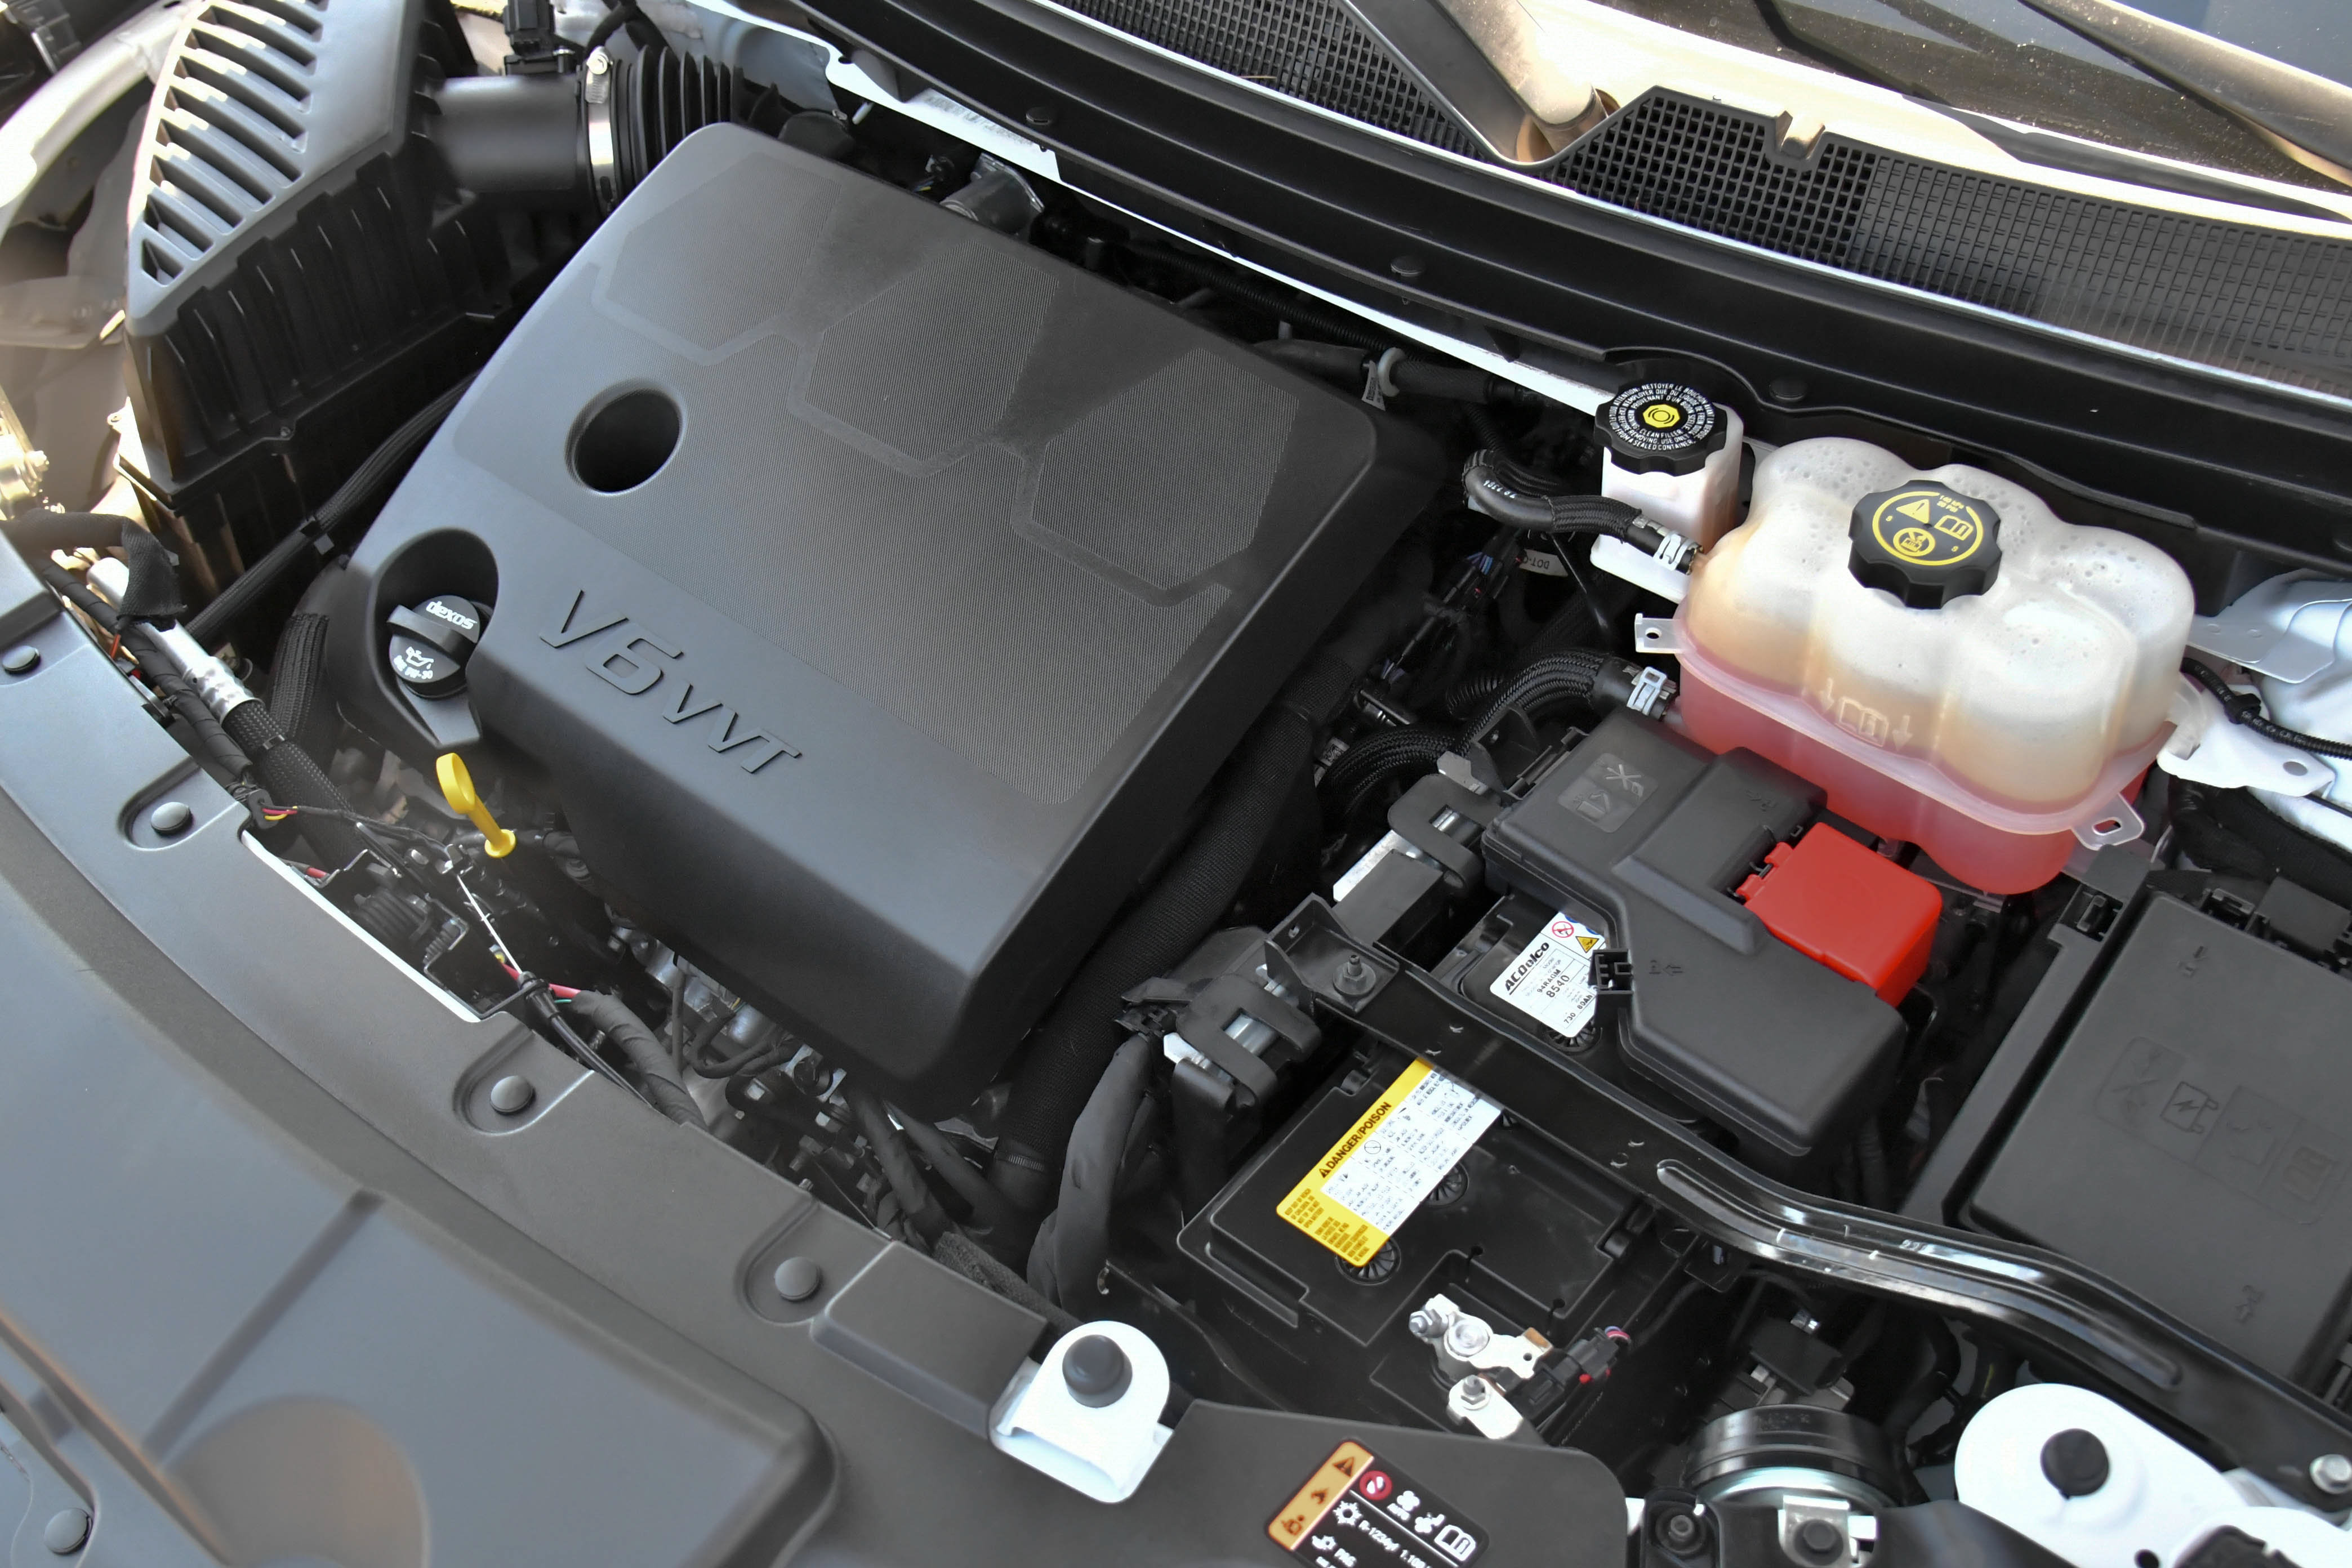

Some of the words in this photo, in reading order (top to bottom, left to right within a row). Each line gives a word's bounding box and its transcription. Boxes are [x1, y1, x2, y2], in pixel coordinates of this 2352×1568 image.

[1631, 395, 1663, 409] PROVENANT
[1679, 393, 1699, 406] LIQUIDE
[1683, 387, 1708, 404] BOUCHON
[1704, 404, 1715, 417] AVANT
[1615, 429, 1631, 442] FROM
[1633, 440, 1656, 450] SEALED
[1618, 416, 1632, 432] BEFORE
[1627, 430, 1659, 444] REMOVING.
[1674, 434, 1690, 443] ONLY
[1639, 429, 1659, 438] CLEAN
[1661, 429, 1683, 438] FILLER
[426, 600, 478, 630] dexos
[539, 588, 684, 695] V6
[663, 678, 802, 774] VVT
[1505, 942, 1550, 991] ACDelco
[1537, 969, 1561, 993] 94RAGM
[1546, 974, 1570, 998] 8540
[1563, 1013, 1576, 1024] 730
[1576, 994, 1593, 1010] 80Ah
[1326, 1102, 1392, 1169] DANGER/POISON
